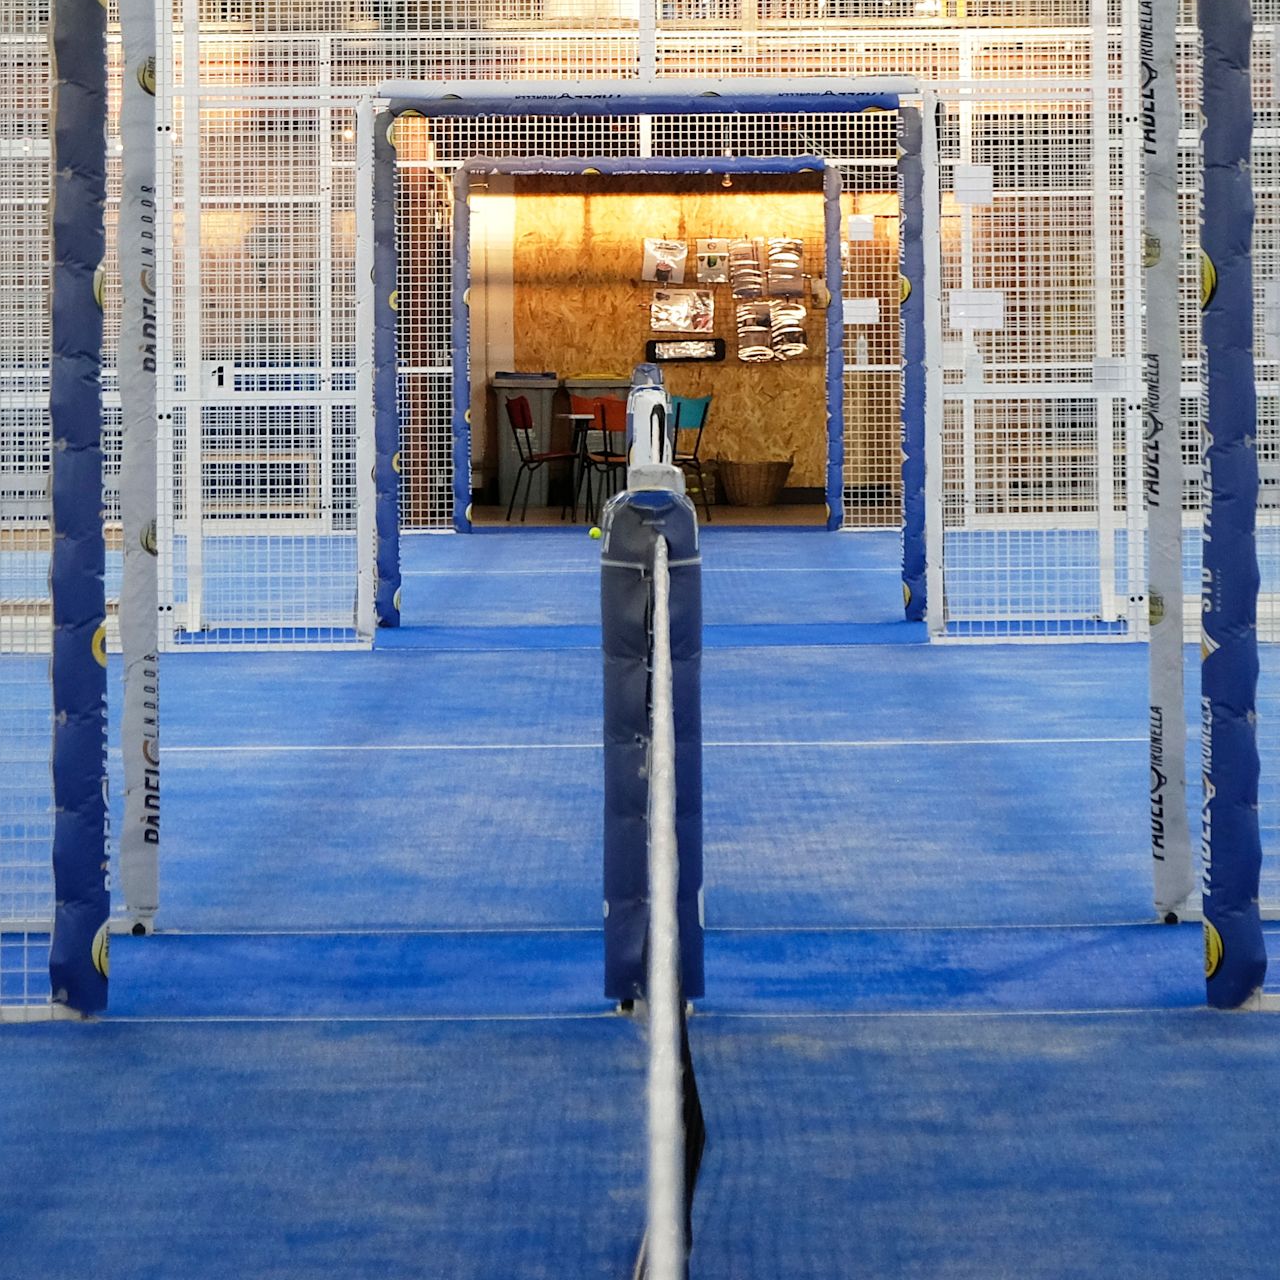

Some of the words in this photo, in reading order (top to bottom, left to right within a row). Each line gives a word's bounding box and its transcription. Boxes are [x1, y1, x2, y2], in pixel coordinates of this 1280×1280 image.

[140, 184, 154, 268] INDOOR
[212, 366, 223, 386] 1
[142, 654, 156, 738] INDOOR
